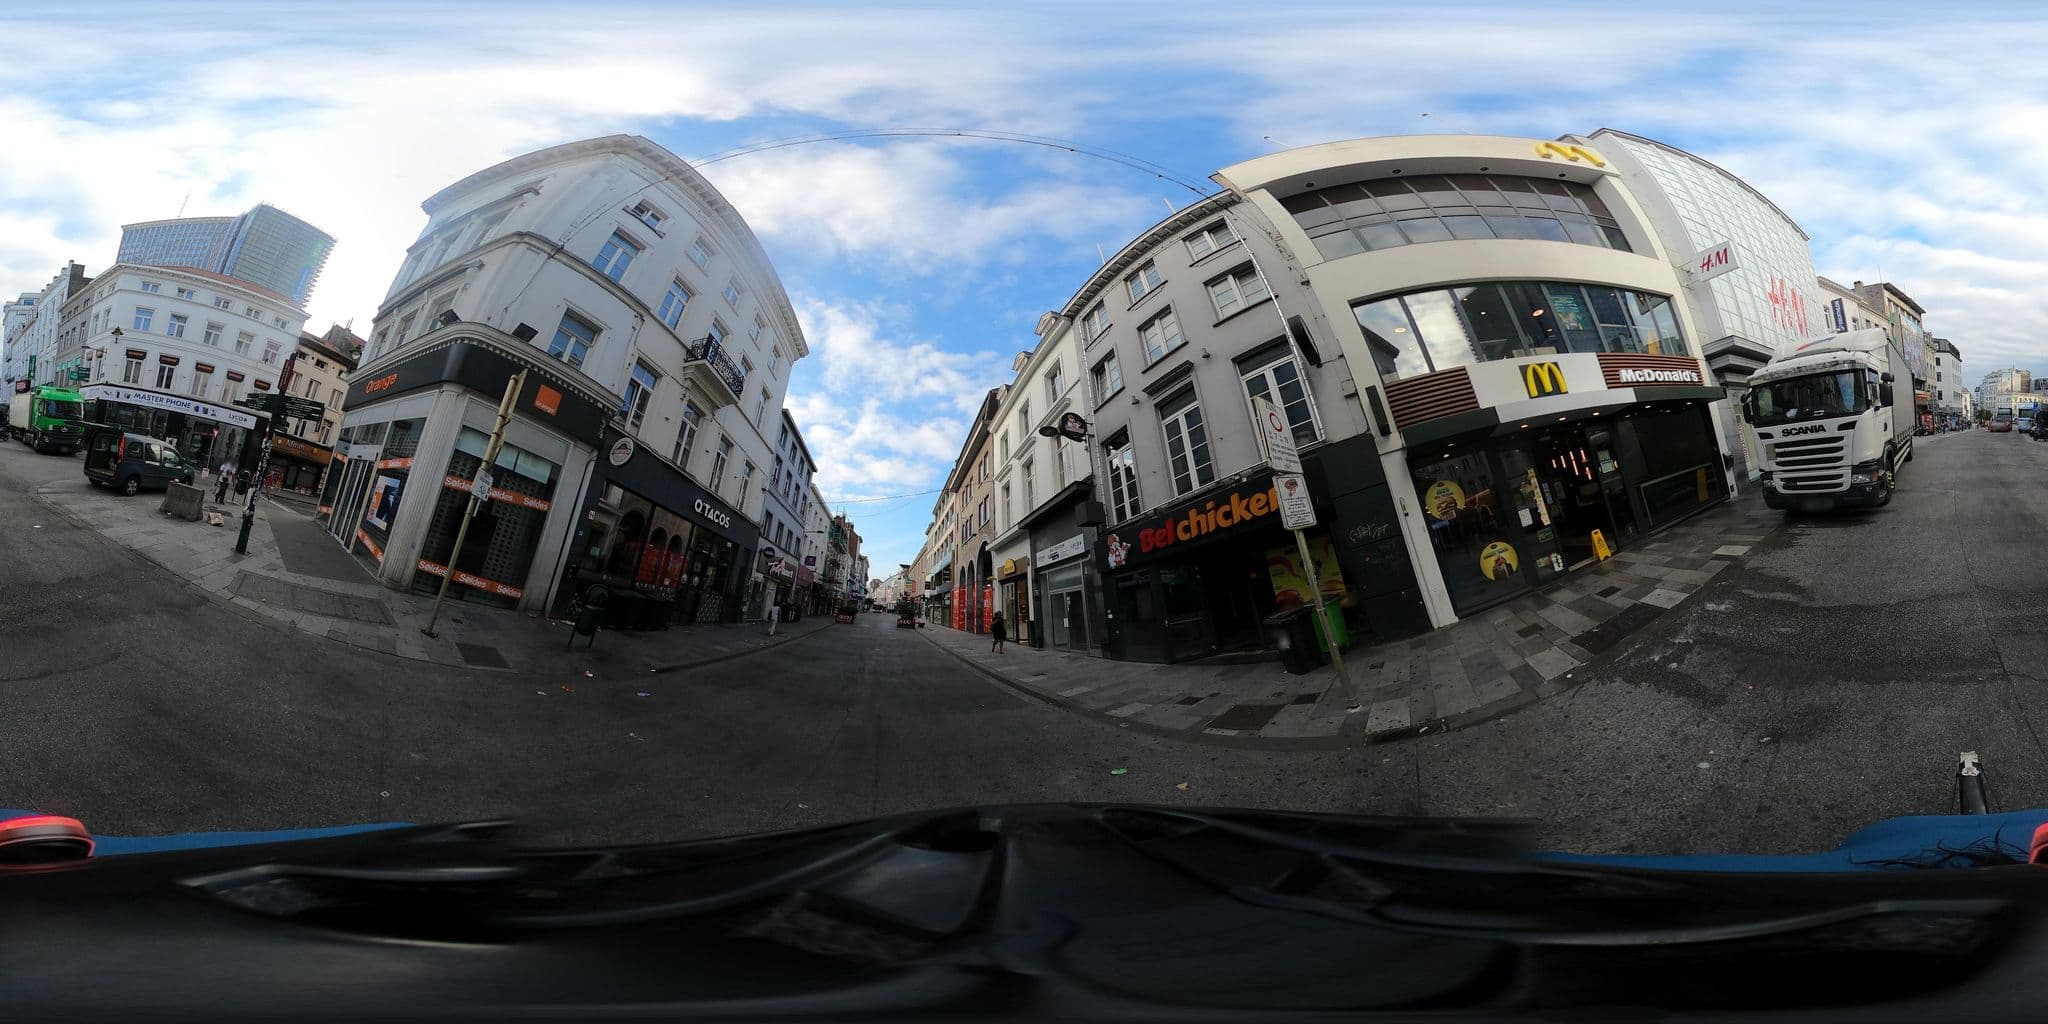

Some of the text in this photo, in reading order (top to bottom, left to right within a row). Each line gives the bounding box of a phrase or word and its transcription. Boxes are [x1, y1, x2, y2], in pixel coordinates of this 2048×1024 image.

[365, 372, 398, 393] Orange
[1620, 369, 1698, 383] McDonald's
[134, 392, 191, 409] MASTER PHONE
[1781, 424, 1827, 437] SCANIA
[523, 497, 549, 511] Soldes
[458, 573, 487, 588] Soldes
